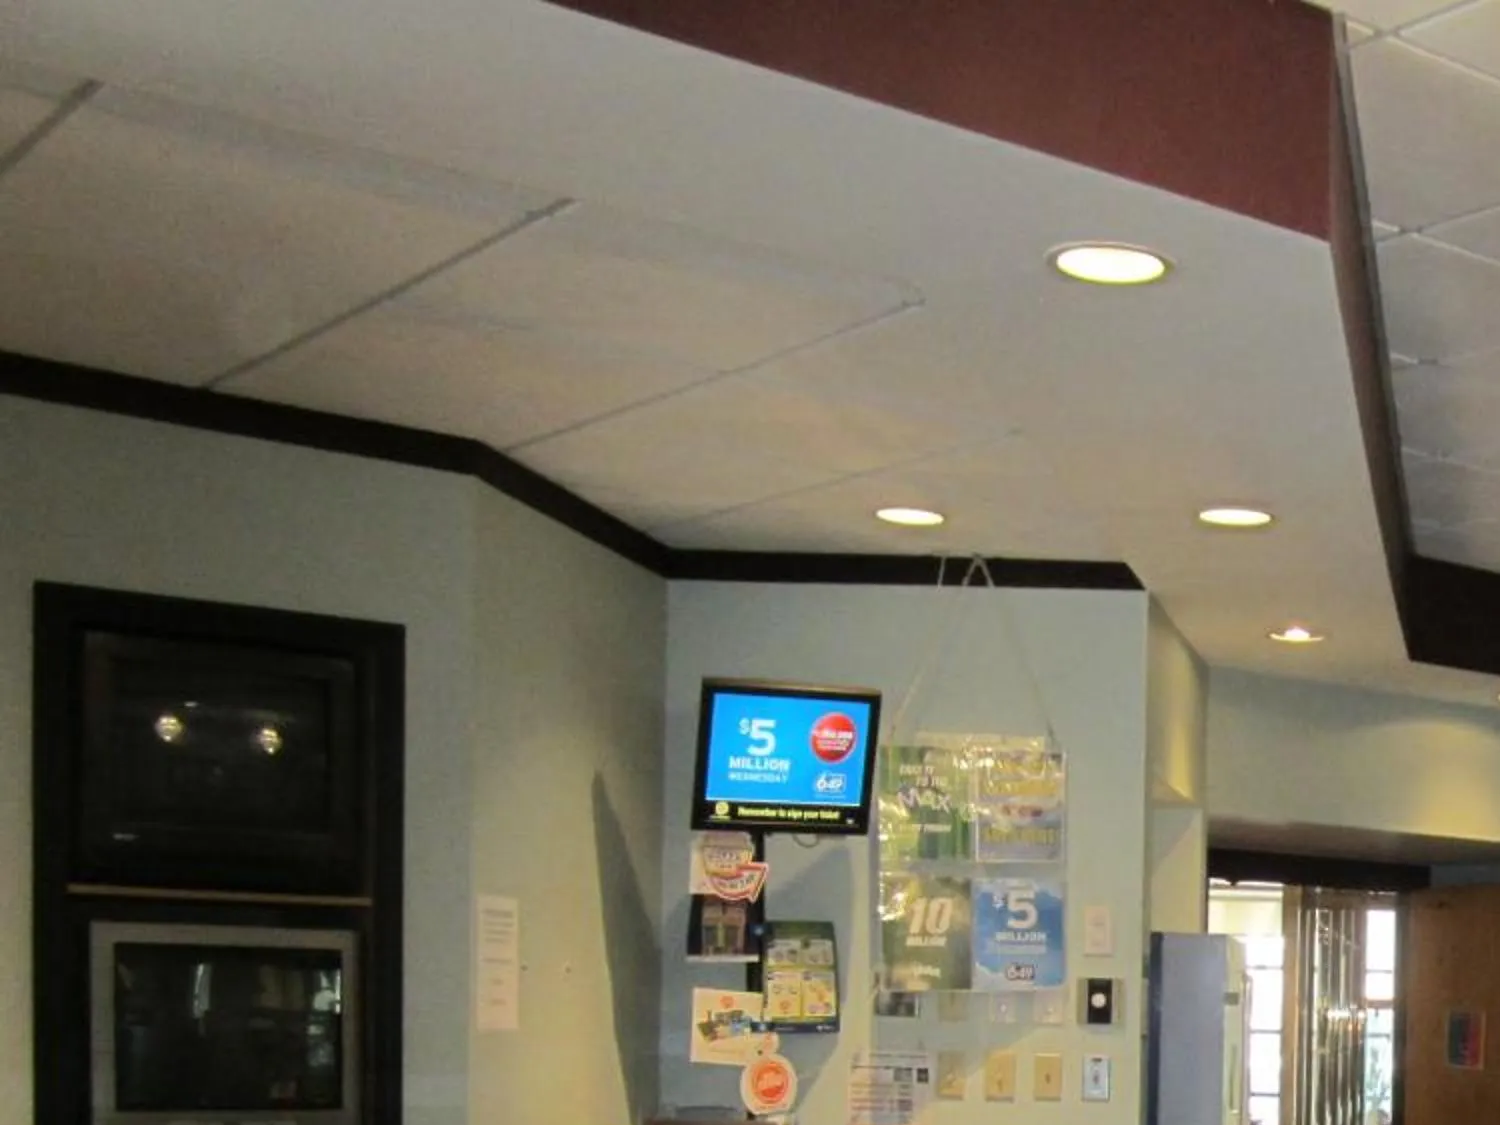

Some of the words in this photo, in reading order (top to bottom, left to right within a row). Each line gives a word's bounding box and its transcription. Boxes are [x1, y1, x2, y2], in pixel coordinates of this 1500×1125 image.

[739, 718, 777, 757] $5
[728, 756, 790, 771] MILLION
[727, 771, 788, 784] WEDNESDAY
[897, 786, 951, 813] MAX
[737, 806, 777, 818] Remember
[778, 807, 787, 818] to
[907, 897, 954, 935] 10
[992, 887, 1039, 929] $5
[994, 930, 1047, 943] MILLION
